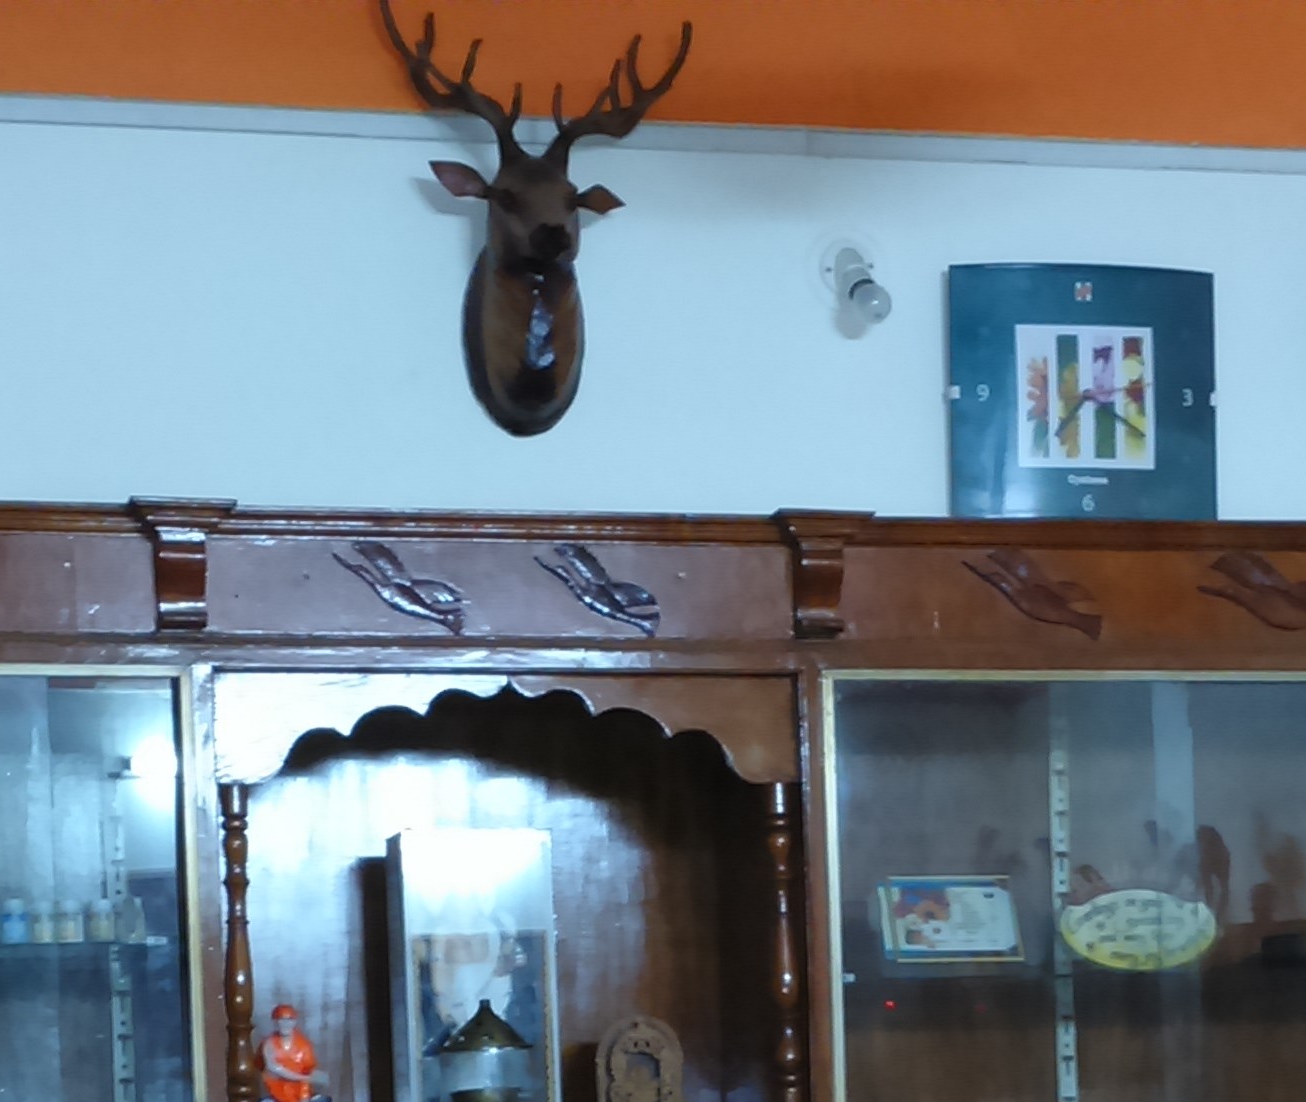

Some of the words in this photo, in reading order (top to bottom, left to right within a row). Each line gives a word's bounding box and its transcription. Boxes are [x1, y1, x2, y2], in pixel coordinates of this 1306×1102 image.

[976, 384, 990, 401] 9
[1182, 388, 1194, 407] 3
[1082, 494, 1095, 511] 6
